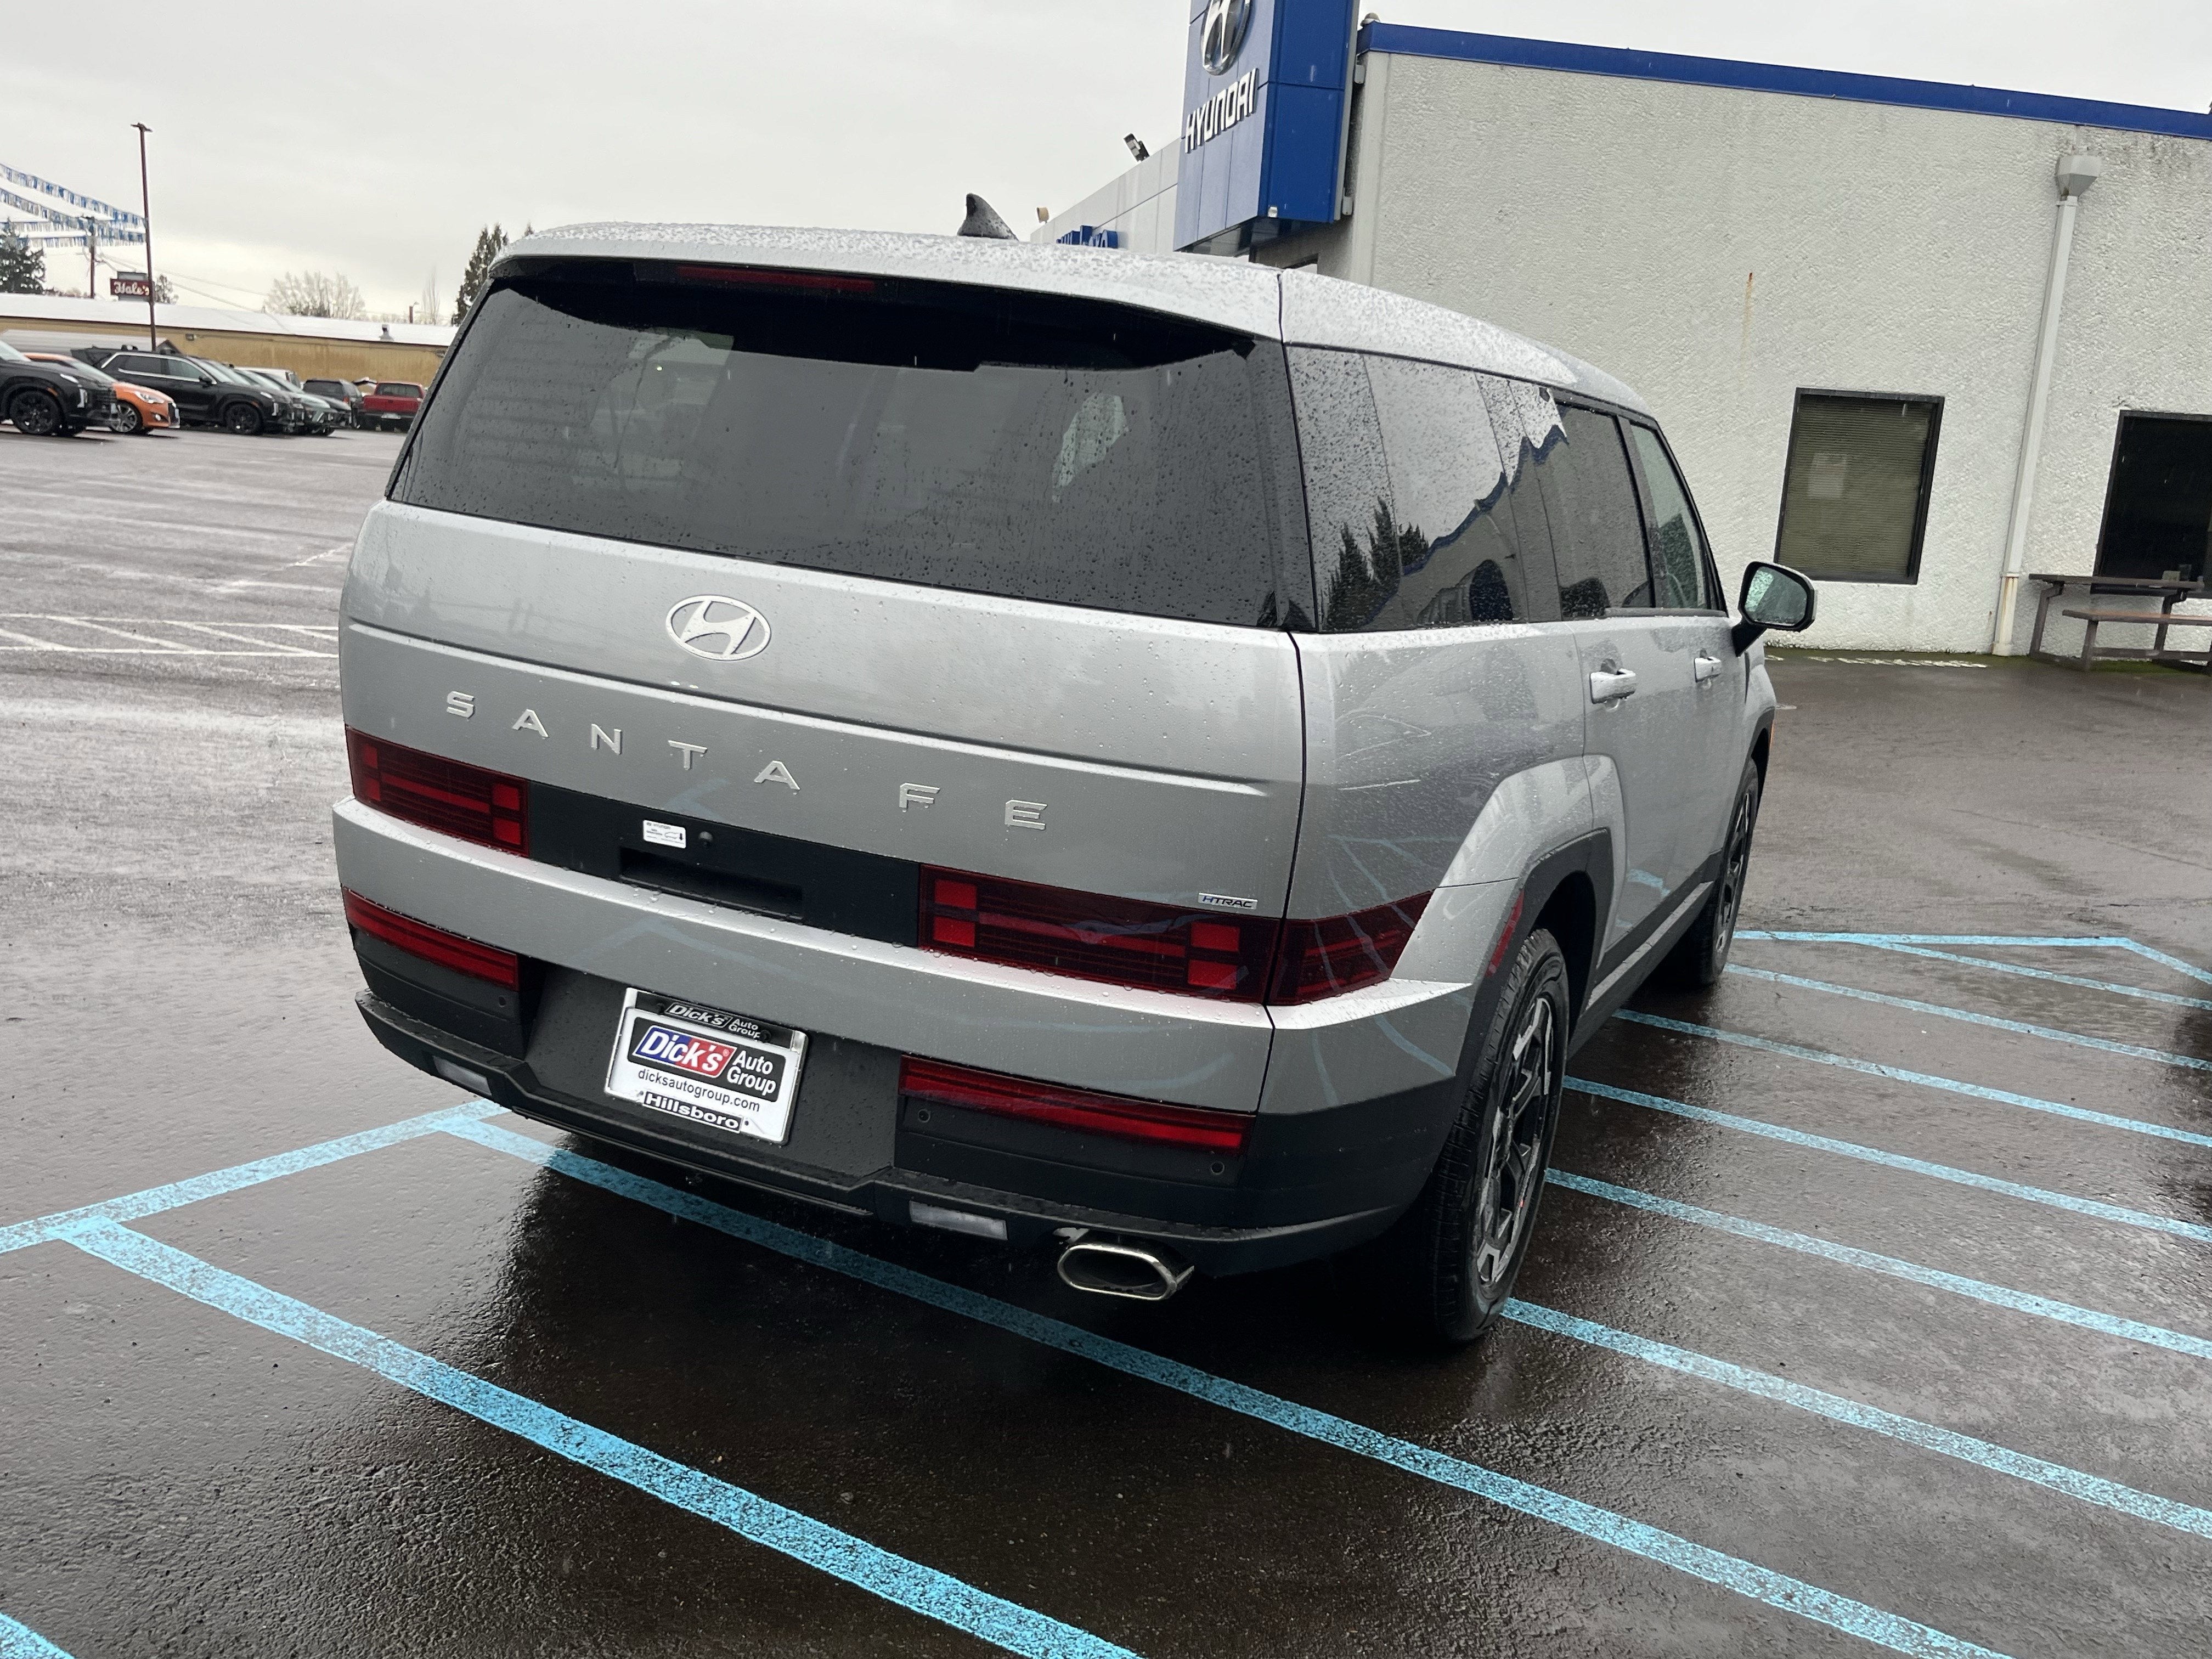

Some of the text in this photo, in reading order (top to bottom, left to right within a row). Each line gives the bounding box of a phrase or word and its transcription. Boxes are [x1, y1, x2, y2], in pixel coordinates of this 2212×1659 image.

[1185, 68, 1258, 153] HYUNDAI
[446, 691, 1048, 831] SANTA FE
[1203, 895, 1253, 907] HTRAC
[669, 1005, 725, 1025] Dick's
[734, 1018, 759, 1030] Auto
[732, 1050, 774, 1075] Auto
[638, 1068, 760, 1112] dicksautogroup.com
[727, 1066, 777, 1096] Group
[645, 1092, 740, 1129] Hillsboro
